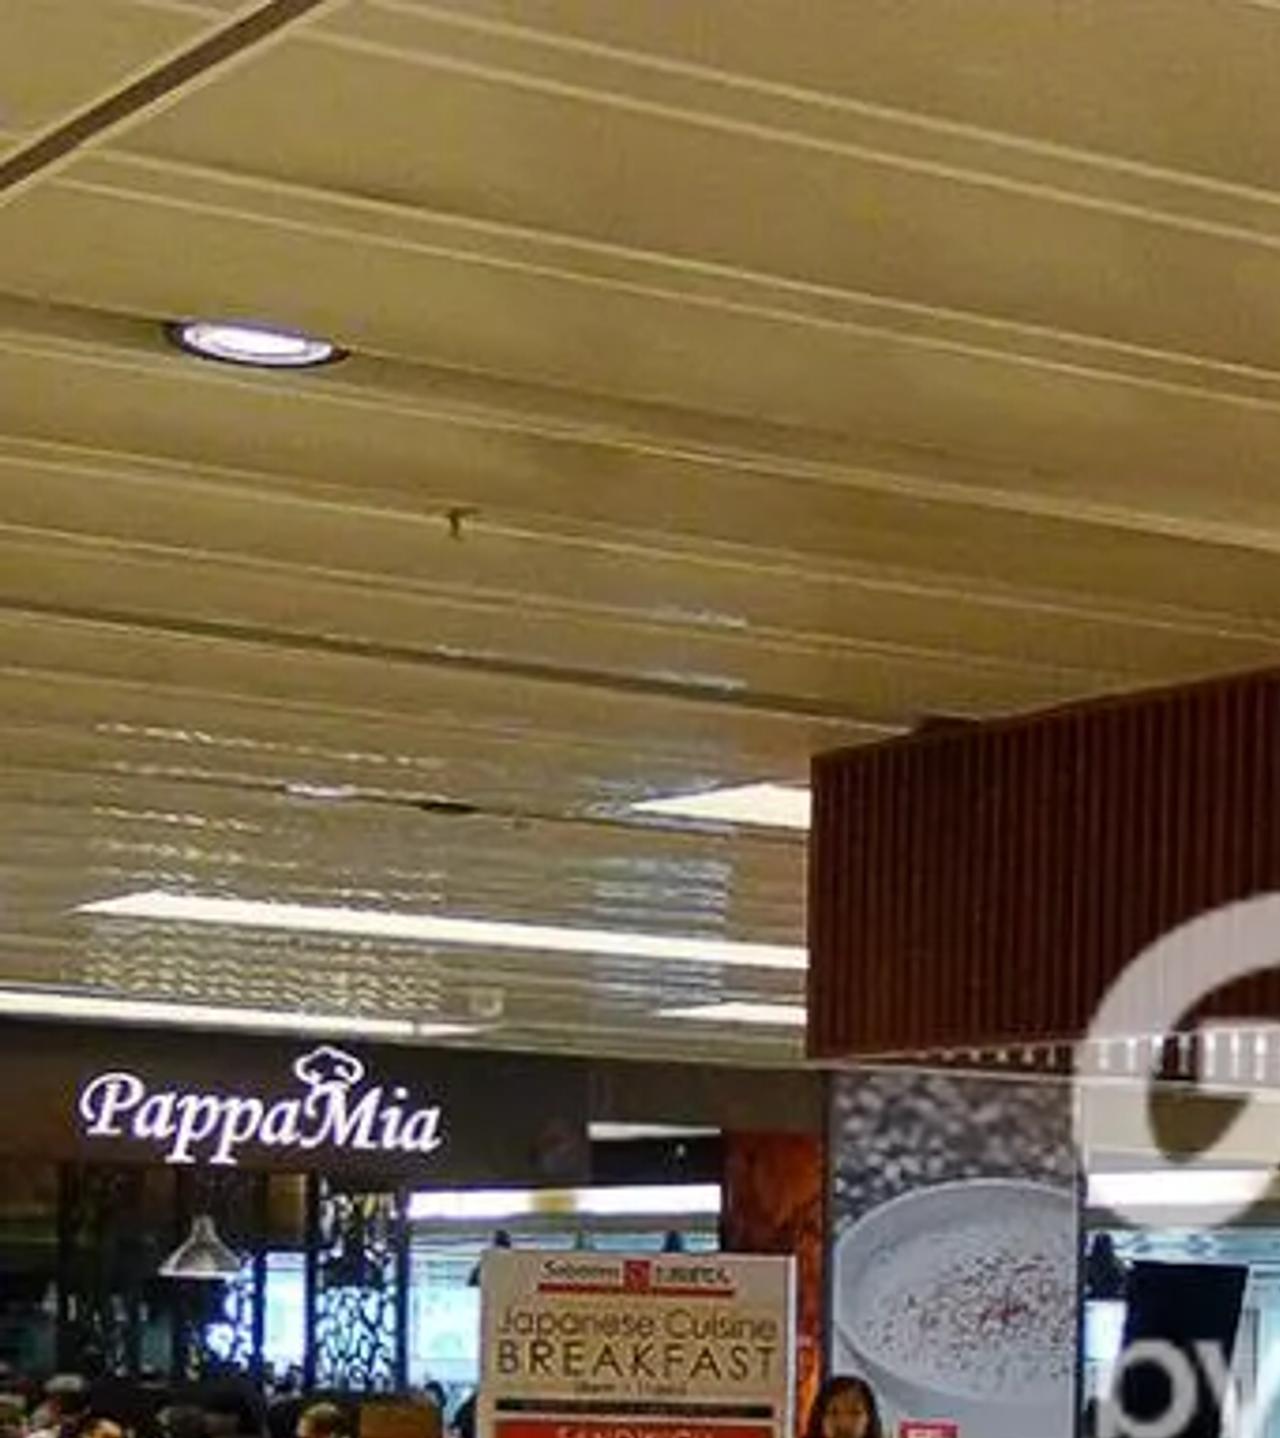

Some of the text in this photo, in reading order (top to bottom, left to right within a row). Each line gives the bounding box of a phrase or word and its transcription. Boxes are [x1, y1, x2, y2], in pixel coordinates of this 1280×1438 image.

[499, 1308, 777, 1342] Japanese Cuisine
[498, 1339, 776, 1380] BREAKFAST
